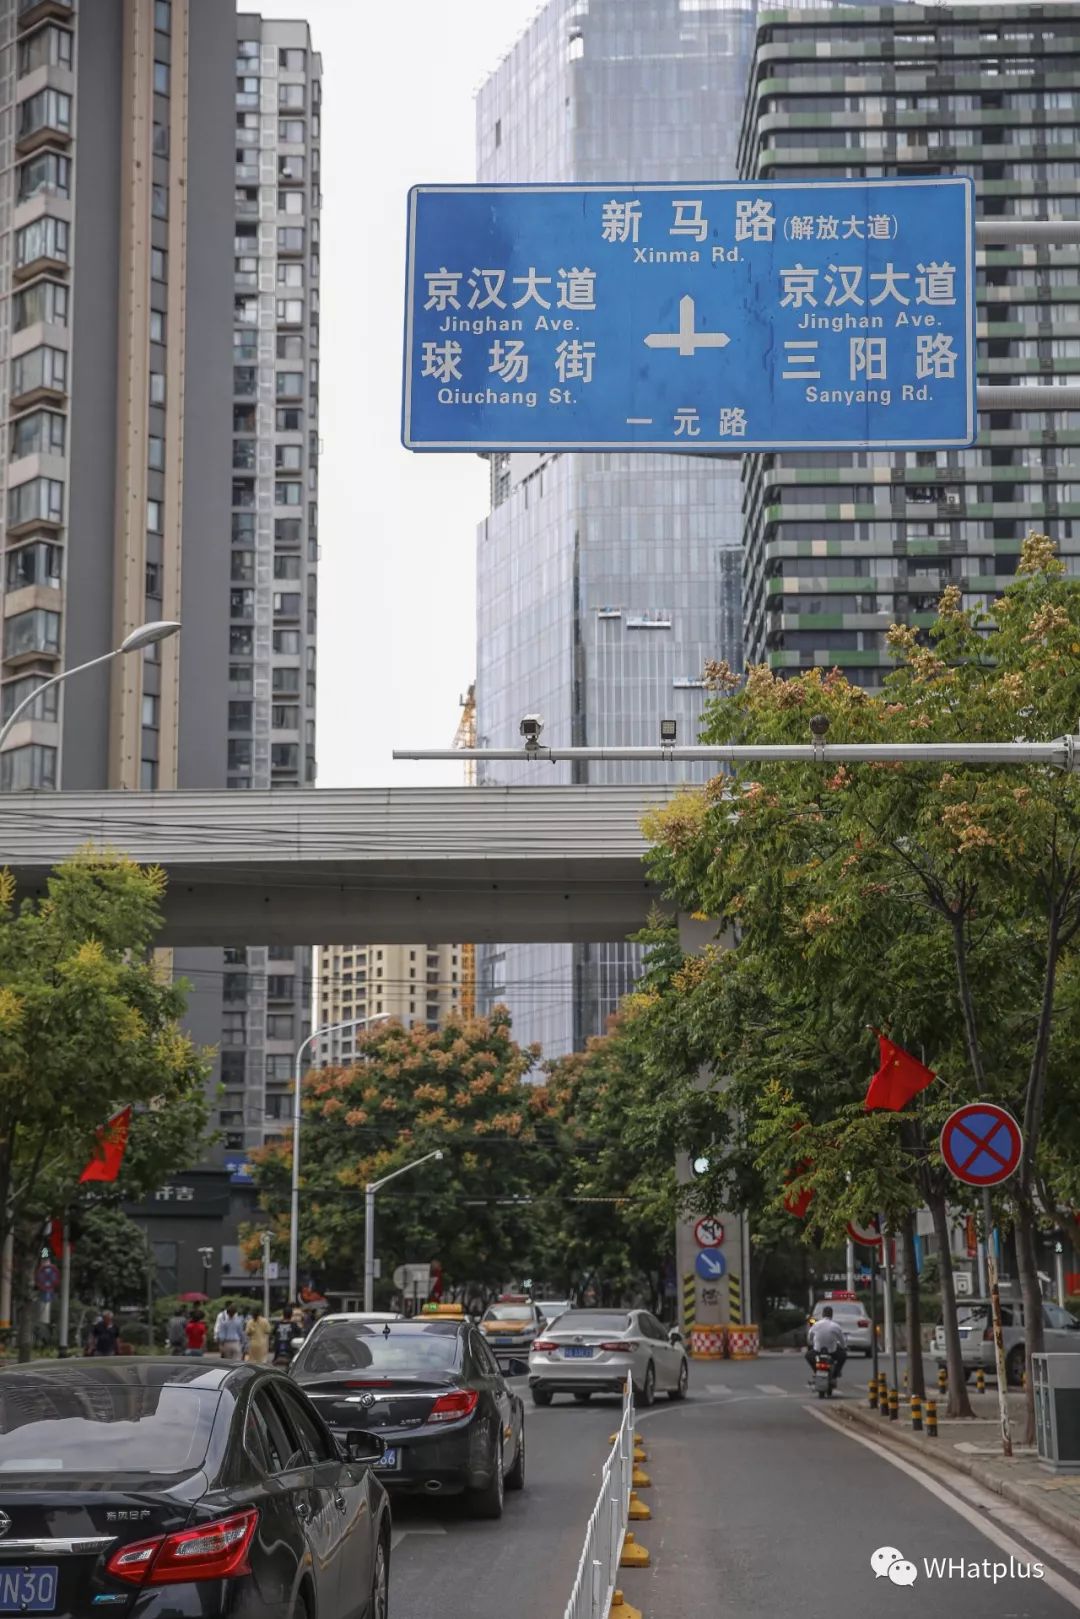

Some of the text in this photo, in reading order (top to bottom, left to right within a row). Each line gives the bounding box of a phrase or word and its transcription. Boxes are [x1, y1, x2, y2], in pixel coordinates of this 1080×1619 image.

[601, 199, 898, 243] 新马路 (解放大道)
[633, 246, 745, 263] Xinma Rd.
[423, 266, 597, 311] 京汉大道
[779, 261, 957, 308] 京汉大道
[439, 316, 580, 335] Jinghan Ave.
[798, 311, 942, 332] Jinghan Ave.
[421, 339, 596, 384] 球场街
[782, 332, 958, 381] 三阳路
[437, 388, 578, 407] Qiuchang St.
[806, 385, 933, 406] Sanyang Rd.
[626, 407, 748, 437] 一元路
[0, 1573, 54, 1604] N30
